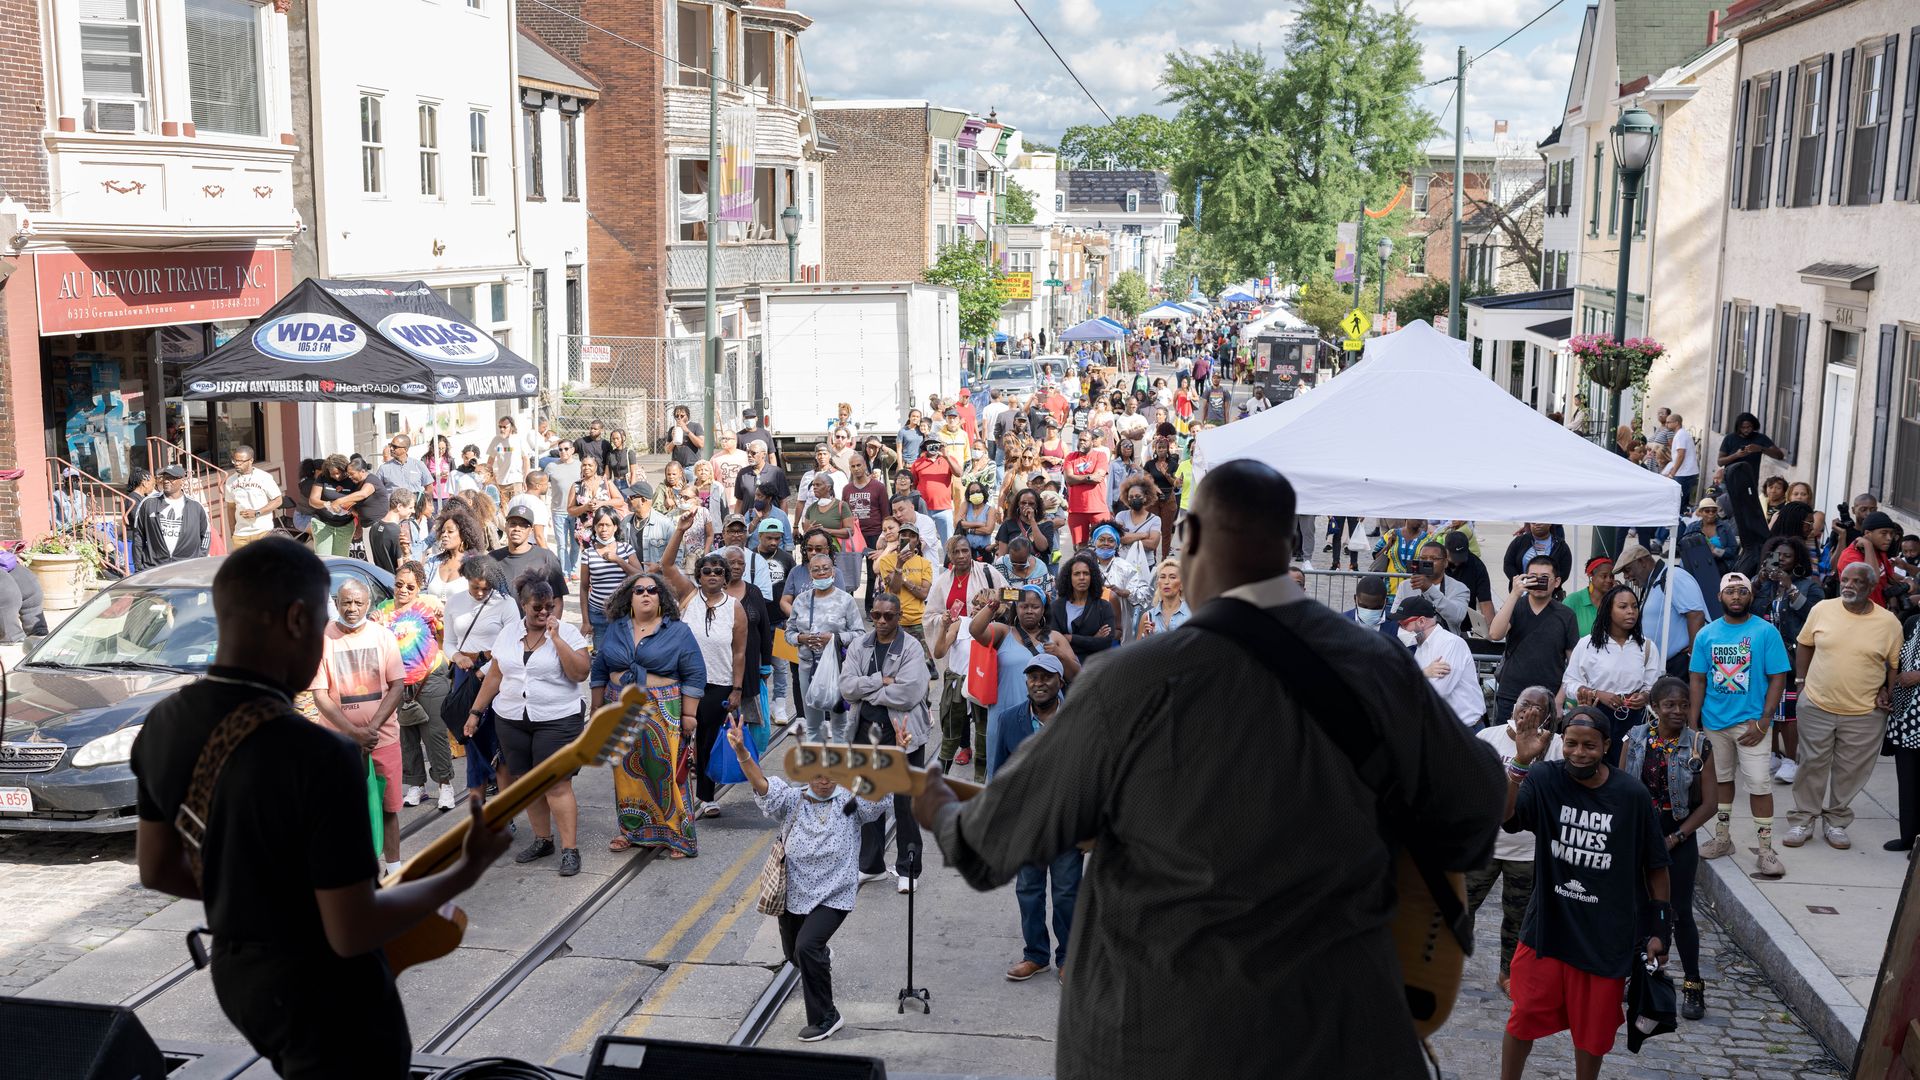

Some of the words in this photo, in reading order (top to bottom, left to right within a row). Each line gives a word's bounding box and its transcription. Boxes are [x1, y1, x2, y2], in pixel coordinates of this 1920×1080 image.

[57, 271, 85, 299] AU
[91, 267, 161, 298] REVOIR
[164, 265, 232, 293] TRAVEL,
[236, 264, 266, 289] INC.
[67, 308, 89, 320] 6373
[92, 307, 143, 319] Germantown
[145, 304, 176, 315] Avenue.
[278, 322, 357, 342] WDAS
[391, 322, 479, 347] WDAS
[297, 342, 318, 352] 105.3
[319, 342, 331, 352] FM
[216, 380, 248, 392] LISTEN
[249, 380, 303, 392] ANYWHERE
[305, 380, 319, 392] ON
[335, 384, 400, 393] iHeartRADIO
[464, 375, 517, 395] WDASFM.COM
[1713, 646, 1738, 656] CROSS
[1713, 655, 1747, 665] COLOURS
[6, 793, 28, 806] 859
[1559, 805, 1613, 833] BLACK
[1559, 825, 1608, 851] LIVES
[1551, 839, 1612, 870] MATTER
